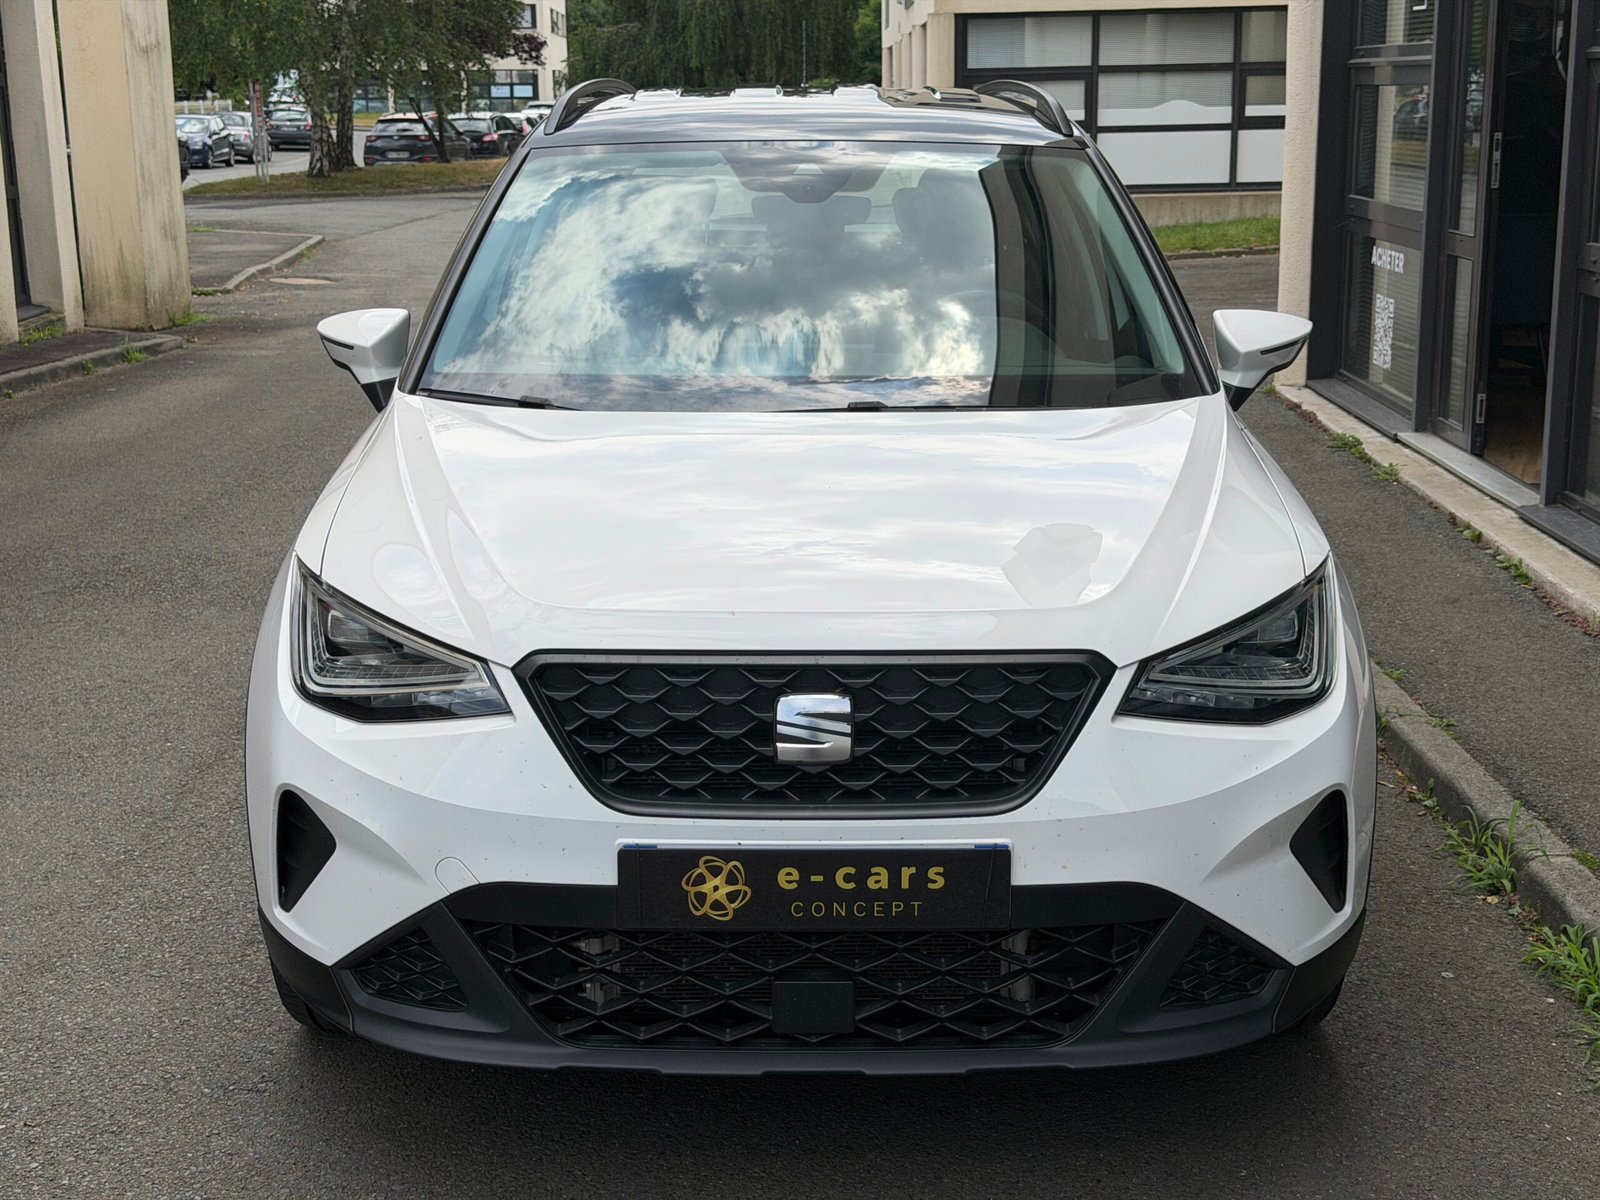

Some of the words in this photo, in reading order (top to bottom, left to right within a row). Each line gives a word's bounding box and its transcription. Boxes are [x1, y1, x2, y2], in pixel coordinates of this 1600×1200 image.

[1371, 245, 1404, 274] ACHETER
[776, 864, 946, 890] e-cars
[790, 901, 923, 917] CONCEPT
